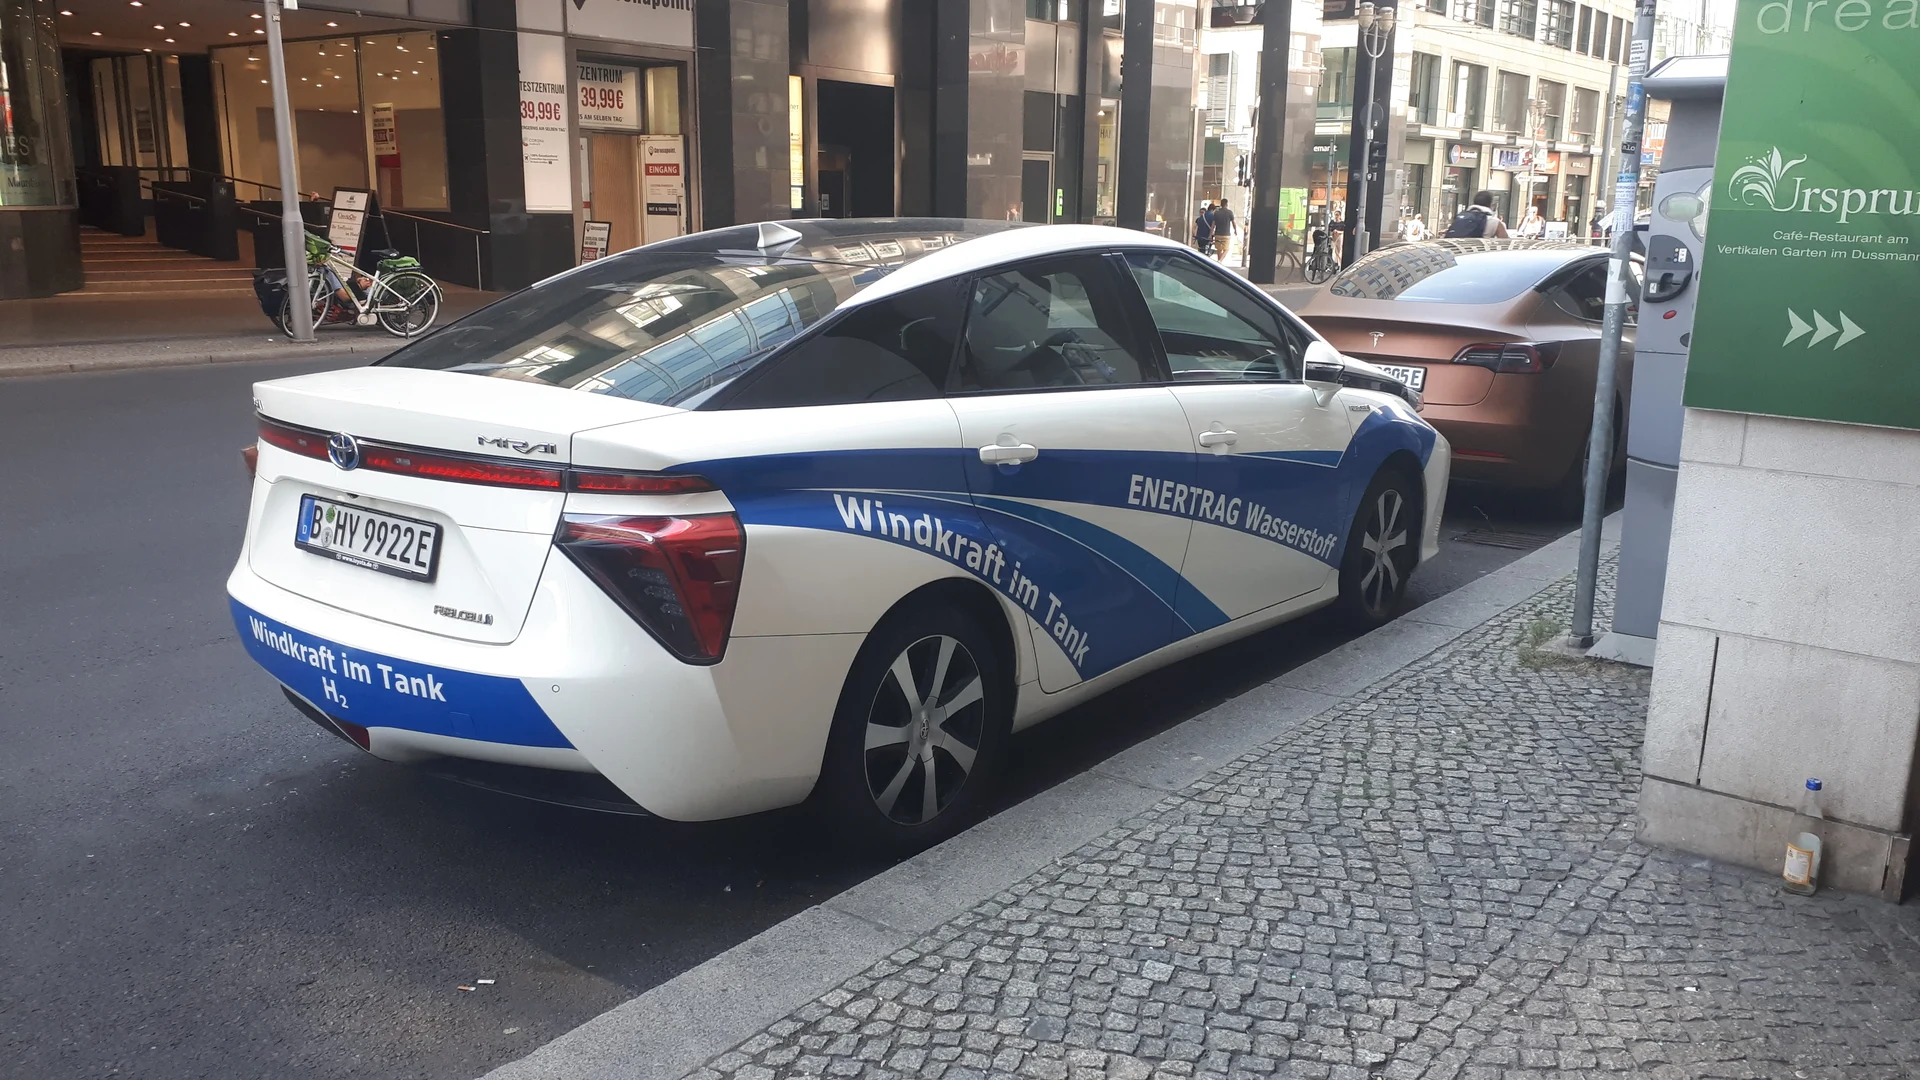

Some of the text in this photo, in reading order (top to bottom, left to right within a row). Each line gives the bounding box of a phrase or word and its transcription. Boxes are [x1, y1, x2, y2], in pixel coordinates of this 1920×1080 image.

[577, 65, 623, 83] ZENTRUM
[519, 81, 565, 95] TESTZENTRUM
[581, 87, 624, 110] 39,99€
[520, 100, 561, 122] 39,99€
[649, 165, 678, 174] EINGANG
[1773, 230, 1909, 244] Café-Restaurant am
[1717, 244, 1777, 256] Vertikalen
[1782, 247, 1827, 258] Garten
[1831, 248, 1847, 258] im
[478, 435, 557, 454] MIRAI
[1127, 474, 1338, 560] ENERTRAG Wasserstoff
[310, 505, 432, 568] B HY 9922E
[833, 493, 1091, 668] Windkraft im Tank
[249, 615, 447, 702] Windkraft im Tank
